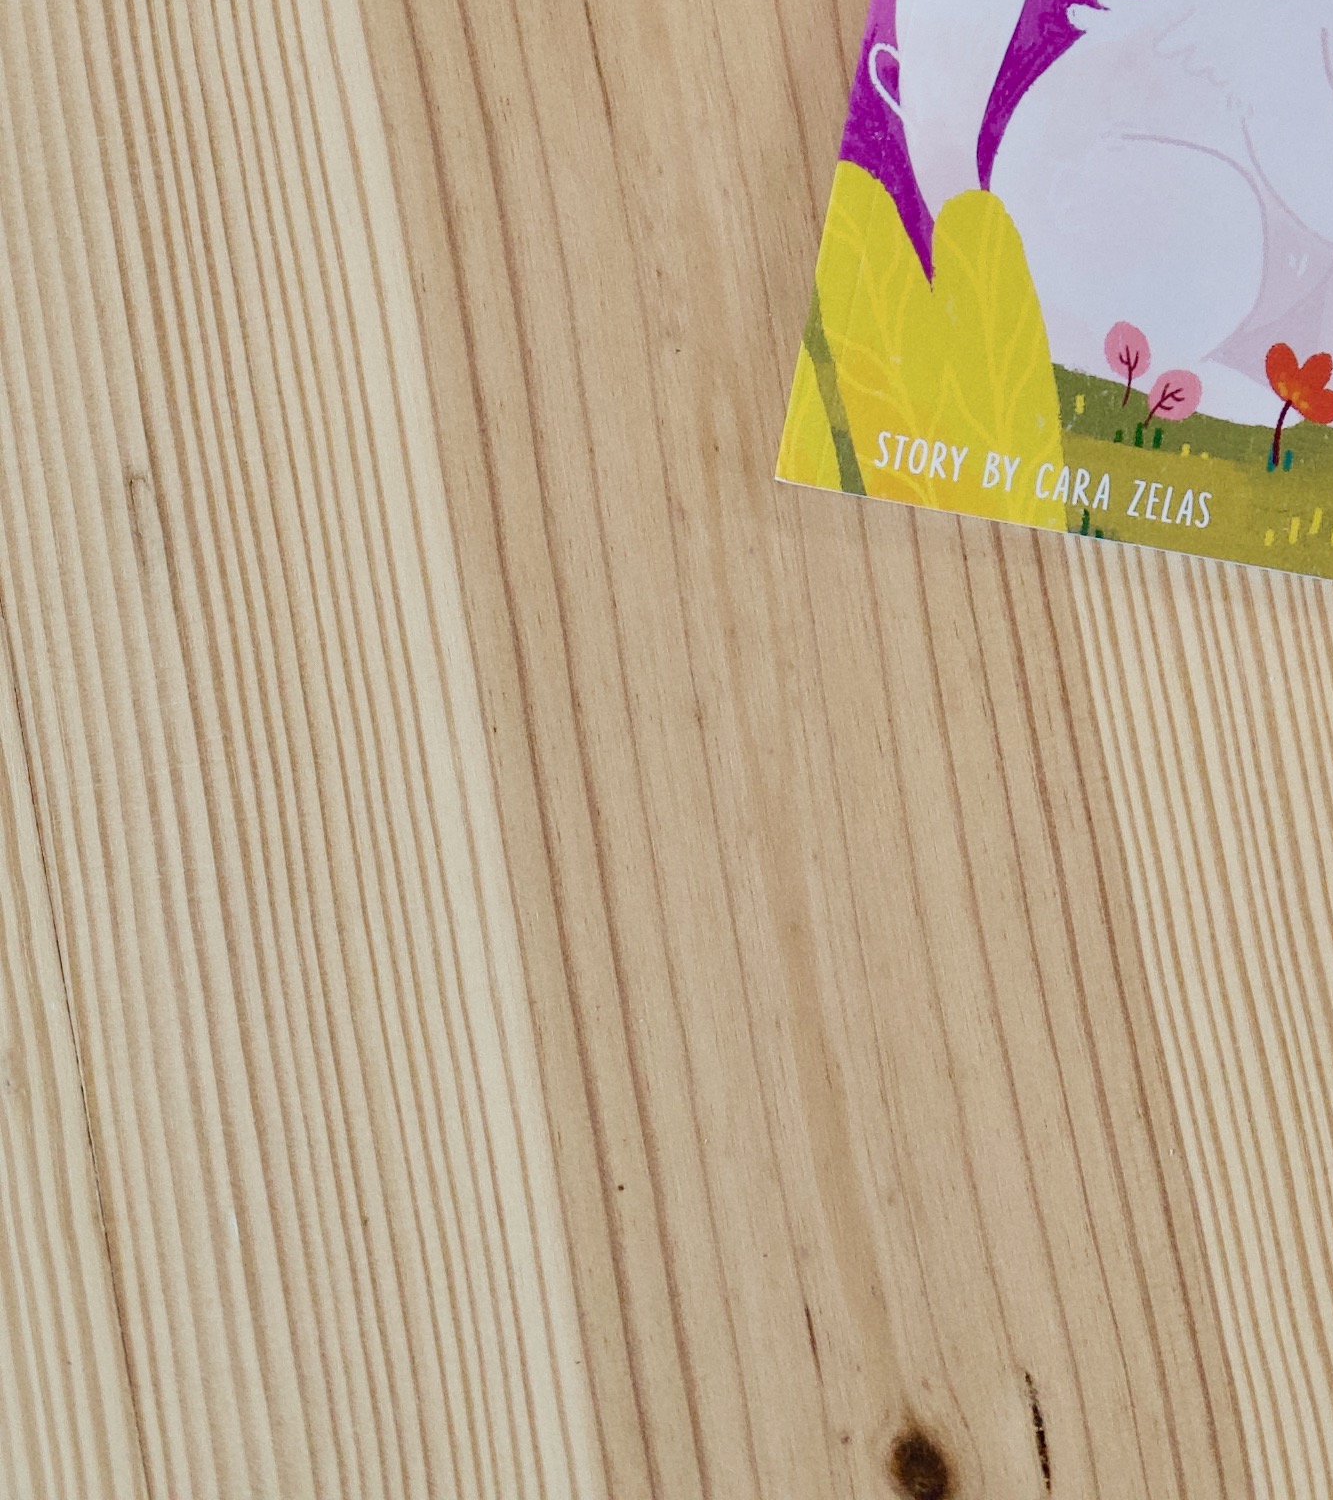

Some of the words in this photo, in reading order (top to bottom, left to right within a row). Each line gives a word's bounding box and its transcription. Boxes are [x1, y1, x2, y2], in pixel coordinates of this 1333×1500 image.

[874, 431, 968, 481] STORY
[982, 451, 1021, 492] BY
[1035, 463, 1110, 510] CARA
[1127, 480, 1211, 528] ZELAS
